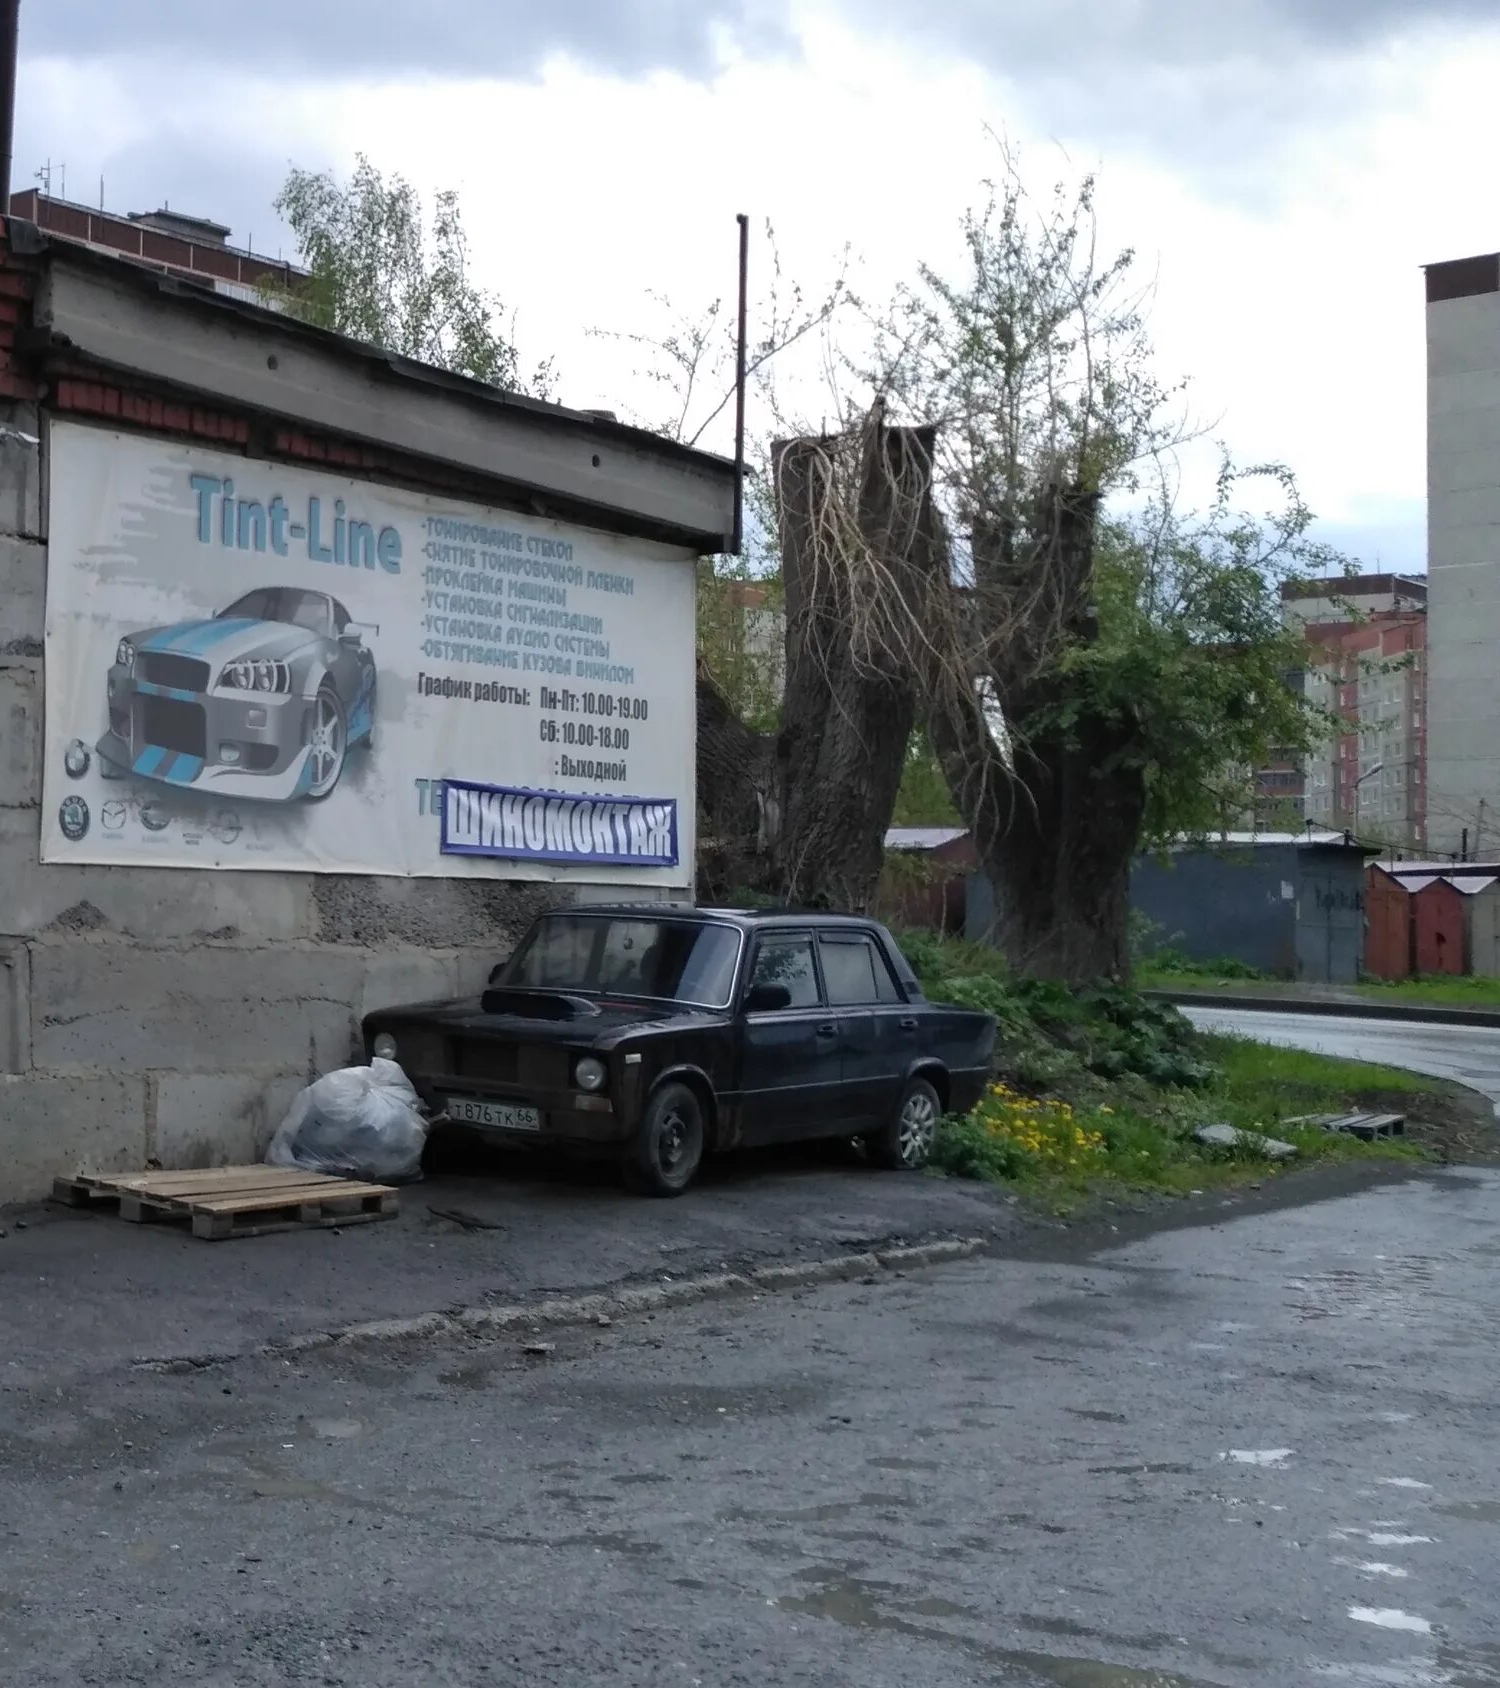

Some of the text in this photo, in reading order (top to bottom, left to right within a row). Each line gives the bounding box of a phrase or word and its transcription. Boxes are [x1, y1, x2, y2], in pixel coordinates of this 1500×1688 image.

[190, 473, 403, 574] Tint-Line
[418, 671, 648, 721] График работы: Пн-Пт: 10.00-19.00
[539, 719, 630, 751] Сб: 10.00-18.00
[560, 753, 627, 783] Выходной
[447, 787, 673, 857] ШИНОМОНТАЖ
[516, 1109, 534, 1123] 66
